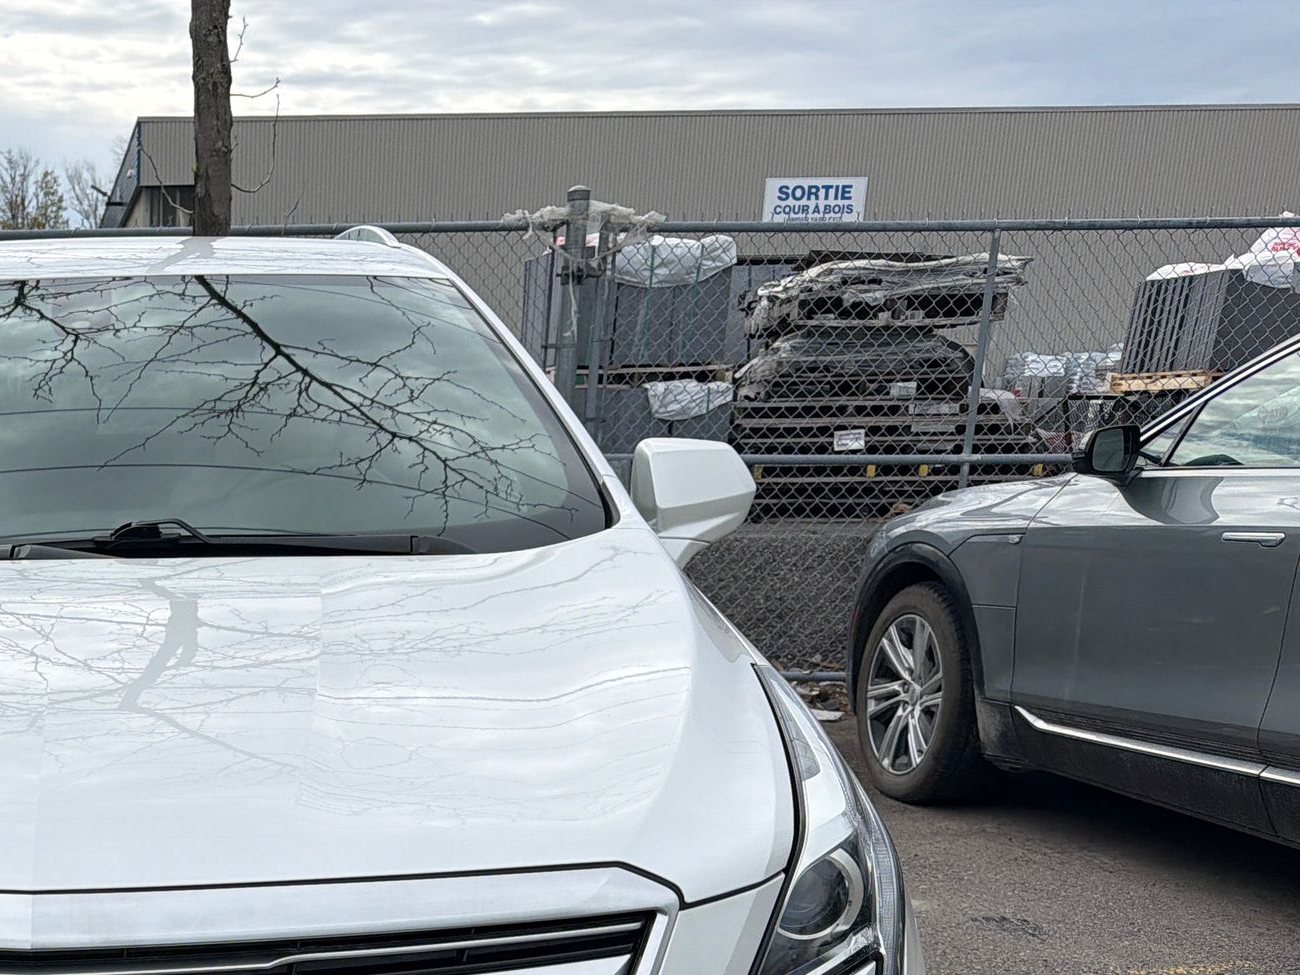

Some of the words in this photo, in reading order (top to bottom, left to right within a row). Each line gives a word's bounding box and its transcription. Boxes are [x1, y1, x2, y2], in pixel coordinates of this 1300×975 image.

[777, 184, 853, 201] SORTIE
[773, 204, 810, 215] COUR
[812, 202, 821, 214] À
[823, 204, 854, 214] BOIS
